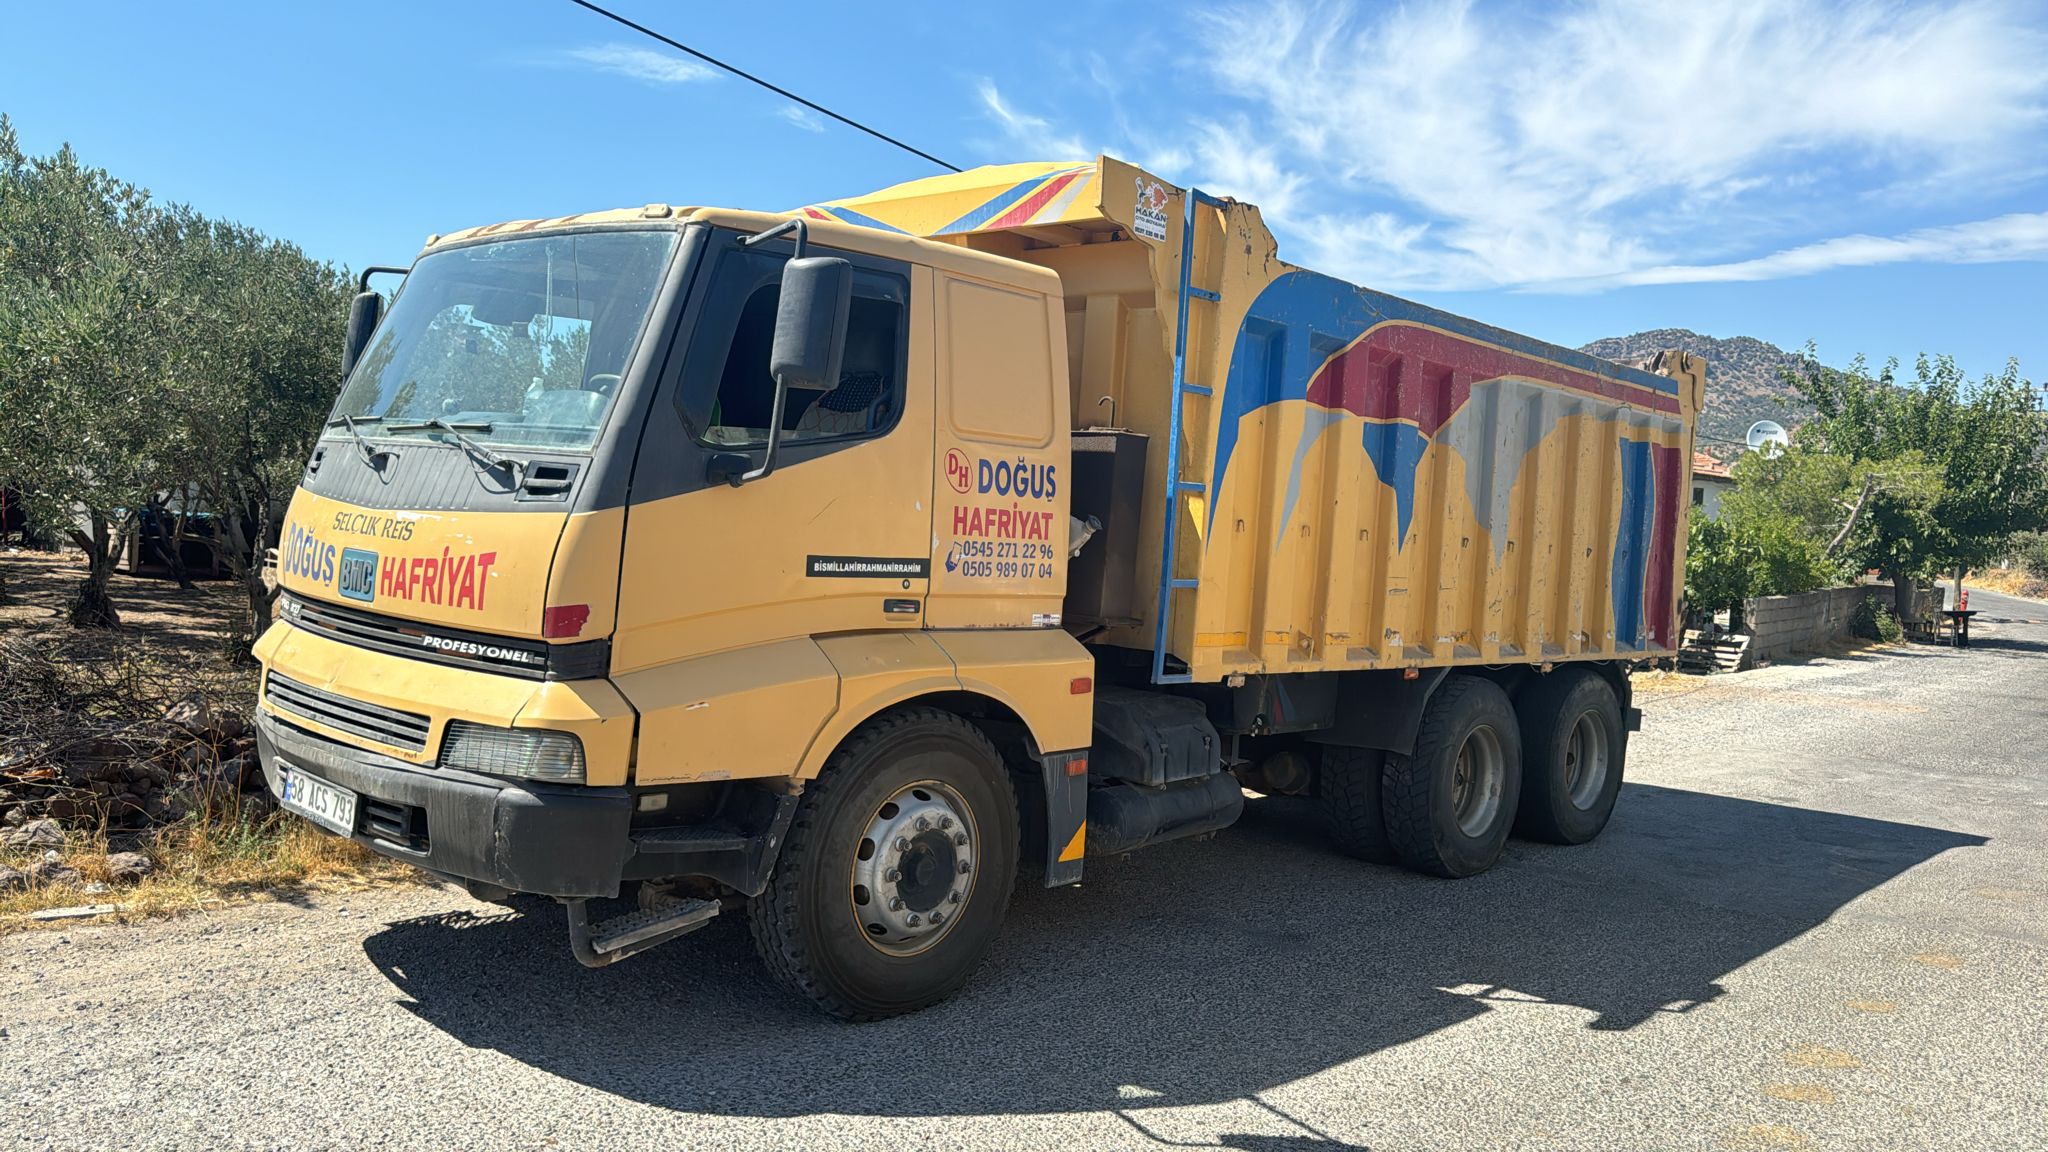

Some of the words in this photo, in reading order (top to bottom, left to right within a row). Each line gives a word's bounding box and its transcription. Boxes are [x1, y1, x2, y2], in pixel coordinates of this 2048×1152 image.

[1136, 207, 1166, 222] HAKAN
[977, 455, 1056, 502] DOĞUŞ
[333, 511, 382, 535] SELÇUK
[953, 502, 1053, 540] HAFRİYAT
[285, 522, 336, 587] DOĞUŞ
[963, 540, 993, 558] 0545
[997, 542, 1018, 558] 271
[1022, 543, 1036, 559] 22
[1040, 543, 1053, 559] 96
[342, 558, 374, 595] BMC
[380, 546, 497, 611] HAFRİYAT
[962, 560, 992, 577] 0505
[996, 561, 1017, 577] 989
[1021, 562, 1035, 578] 07
[1038, 562, 1053, 578] 04
[422, 635, 530, 663] PROFESYONEL
[291, 774, 305, 803] 58
[308, 783, 329, 813] ACS
[333, 792, 353, 825] 793
